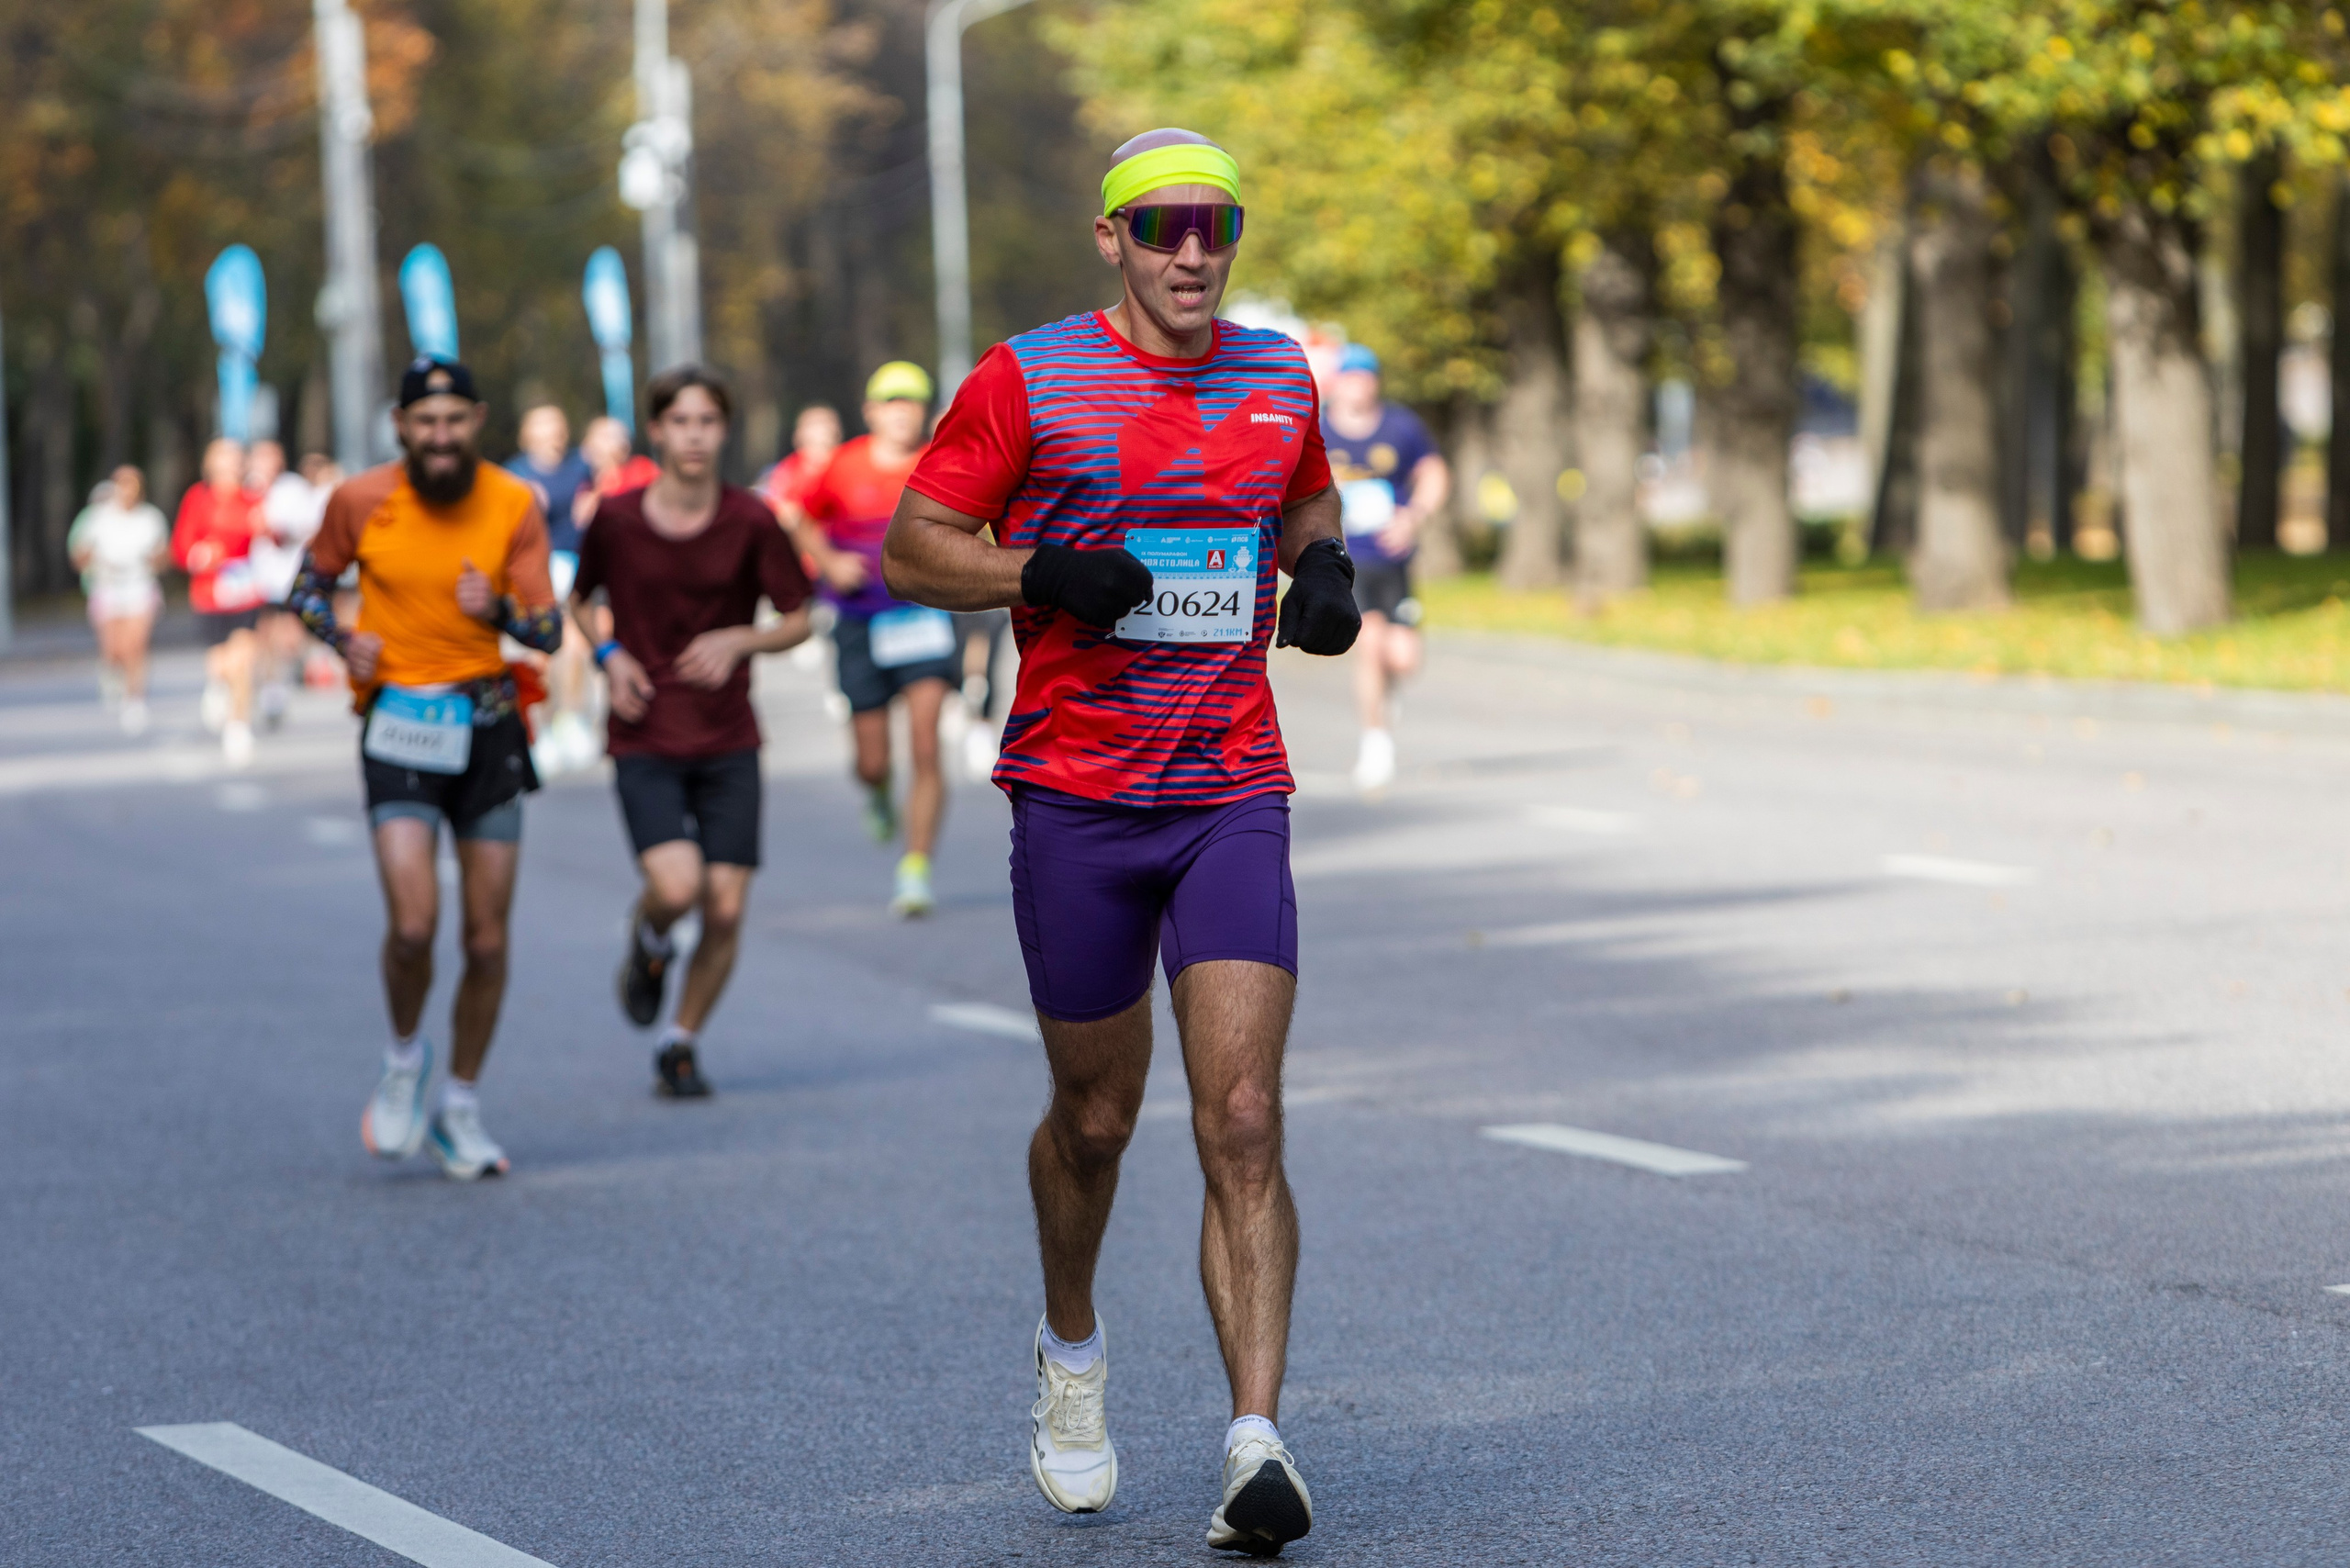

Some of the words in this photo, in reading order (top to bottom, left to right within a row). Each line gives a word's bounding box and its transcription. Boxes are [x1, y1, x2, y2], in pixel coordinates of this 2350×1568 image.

[1250, 413, 1292, 425] INSANITY
[1140, 558, 1158, 566] МОЯ
[1158, 559, 1200, 567] СТОЛИЦА
[1133, 590, 1240, 617] 20624
